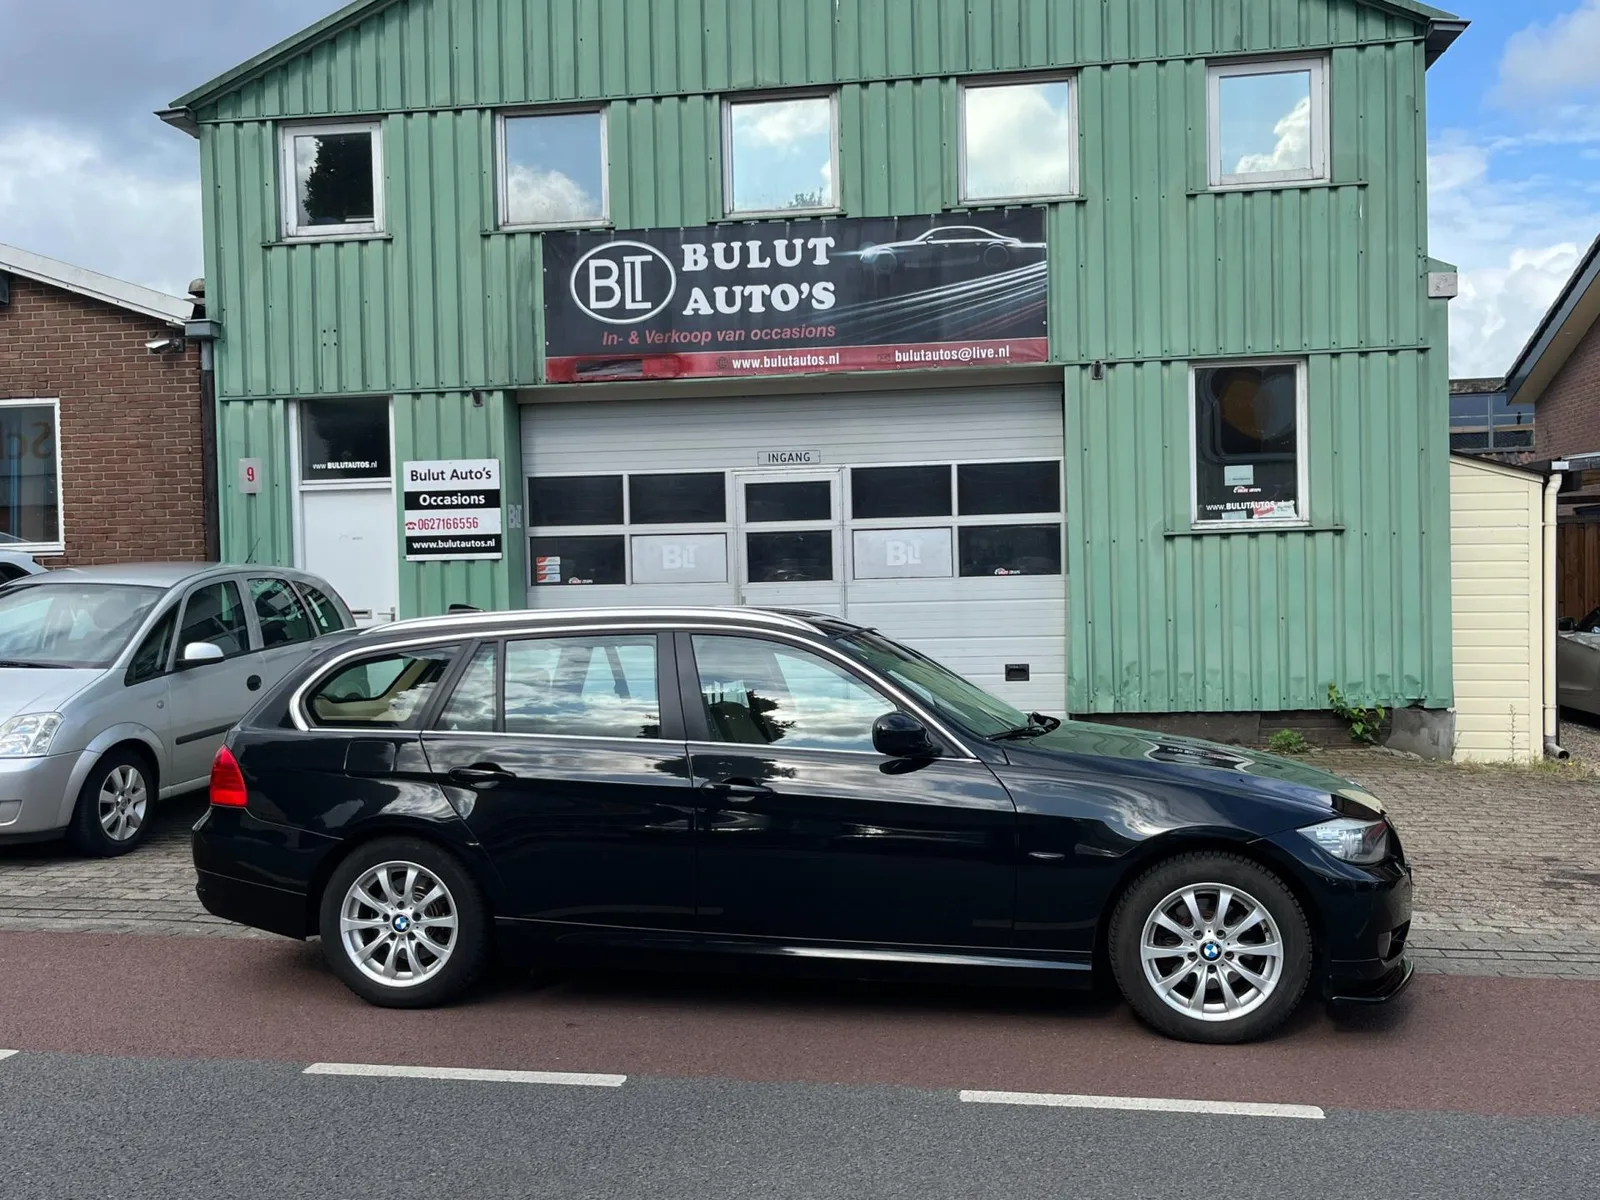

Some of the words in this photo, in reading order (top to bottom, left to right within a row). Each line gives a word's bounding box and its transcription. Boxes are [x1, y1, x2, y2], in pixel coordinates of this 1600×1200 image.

[681, 236, 836, 272] BULUT
[682, 281, 836, 316] AUTO'S
[602, 330, 624, 346] In-
[628, 330, 641, 345] &
[645, 329, 713, 346] Verkoop
[716, 329, 746, 343] van
[750, 324, 837, 341] occasions
[732, 352, 840, 369] www.bulutautos.nl
[895, 345, 1010, 362] bulutautos@live.nl
[767, 452, 811, 463] INGANG
[246, 466, 256, 482] 9
[410, 468, 446, 482] Bulut
[450, 467, 492, 480] Auto's
[419, 493, 486, 506] Occasions
[417, 516, 479, 530] 0627166556
[412, 538, 496, 549] www.bulutautos.nl
